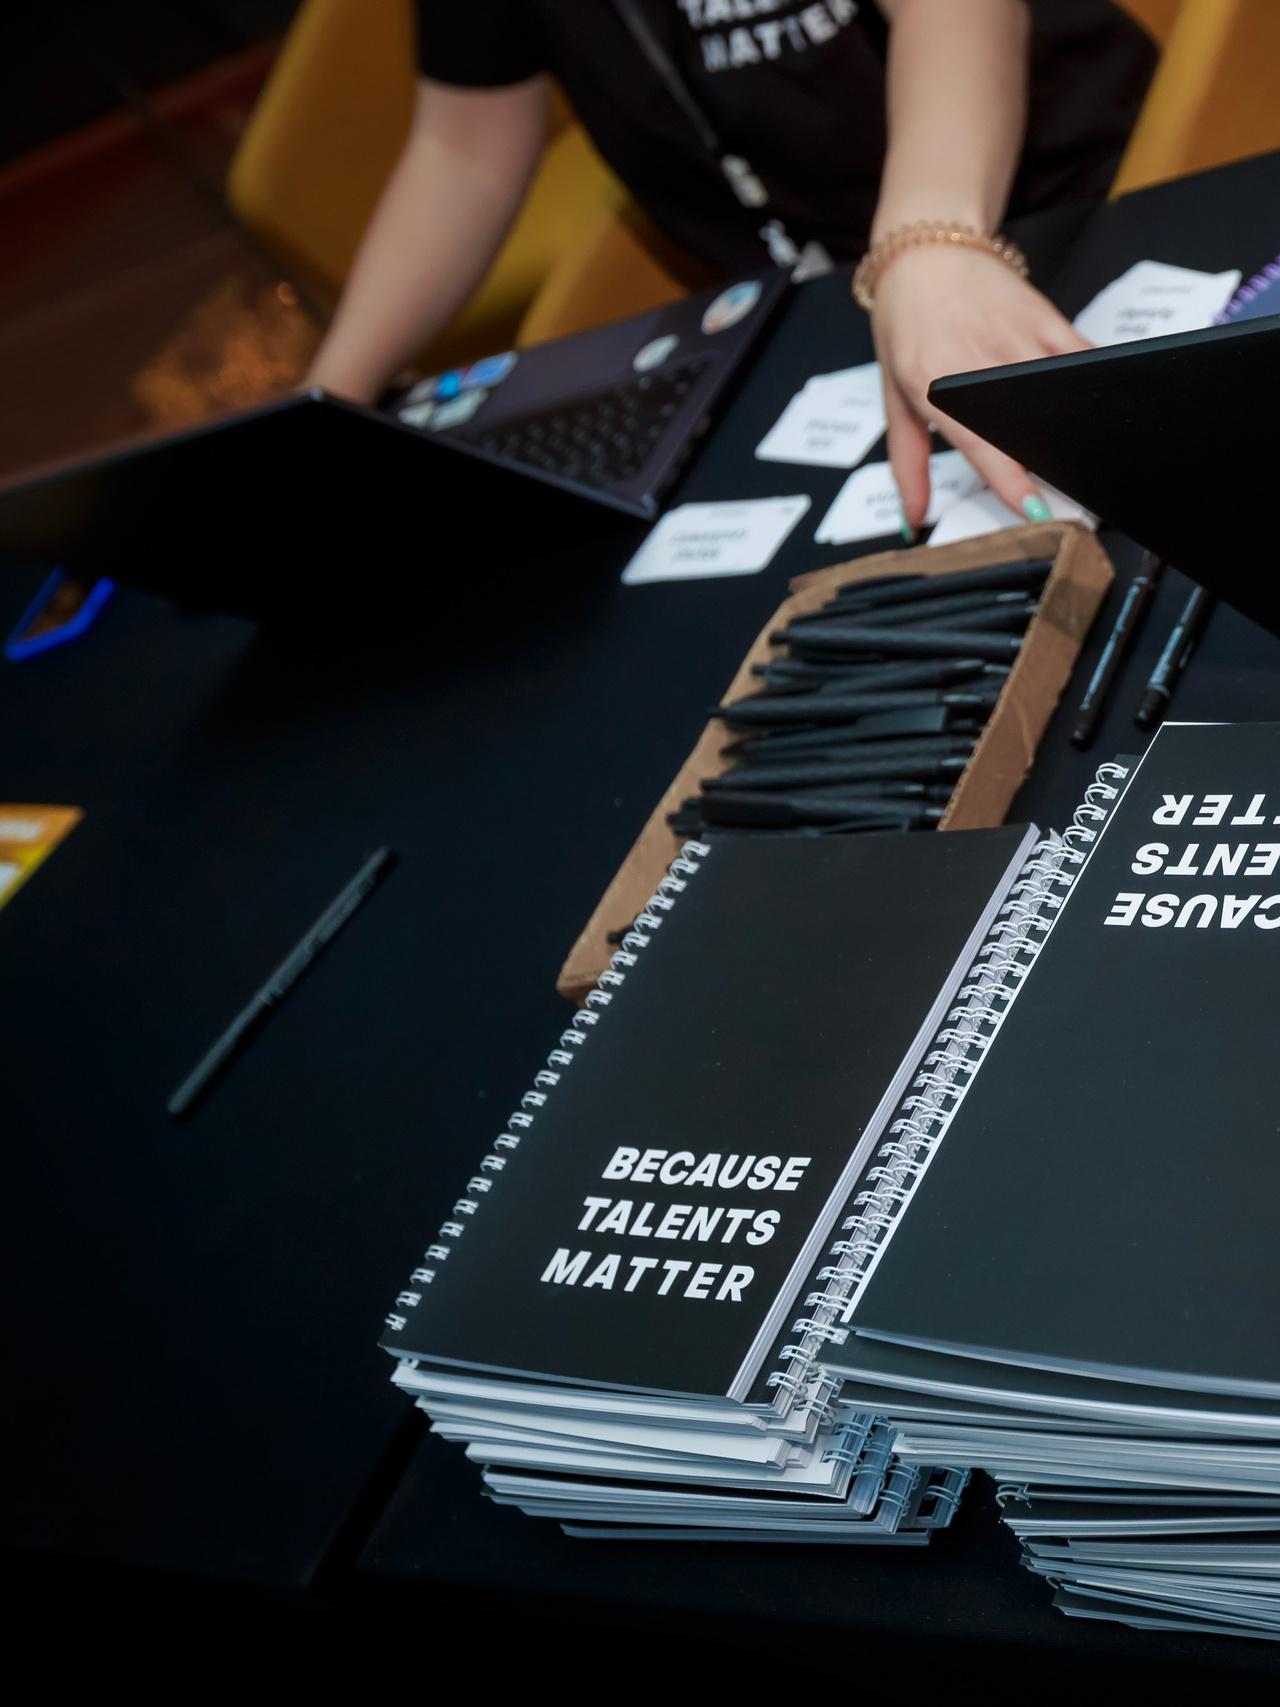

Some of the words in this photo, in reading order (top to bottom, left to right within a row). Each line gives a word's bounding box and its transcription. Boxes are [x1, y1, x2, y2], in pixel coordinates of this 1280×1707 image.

[601, 1146, 812, 1191] BECAUSE
[577, 1196, 781, 1246] TALENTS
[540, 1247, 755, 1302] MATTER
